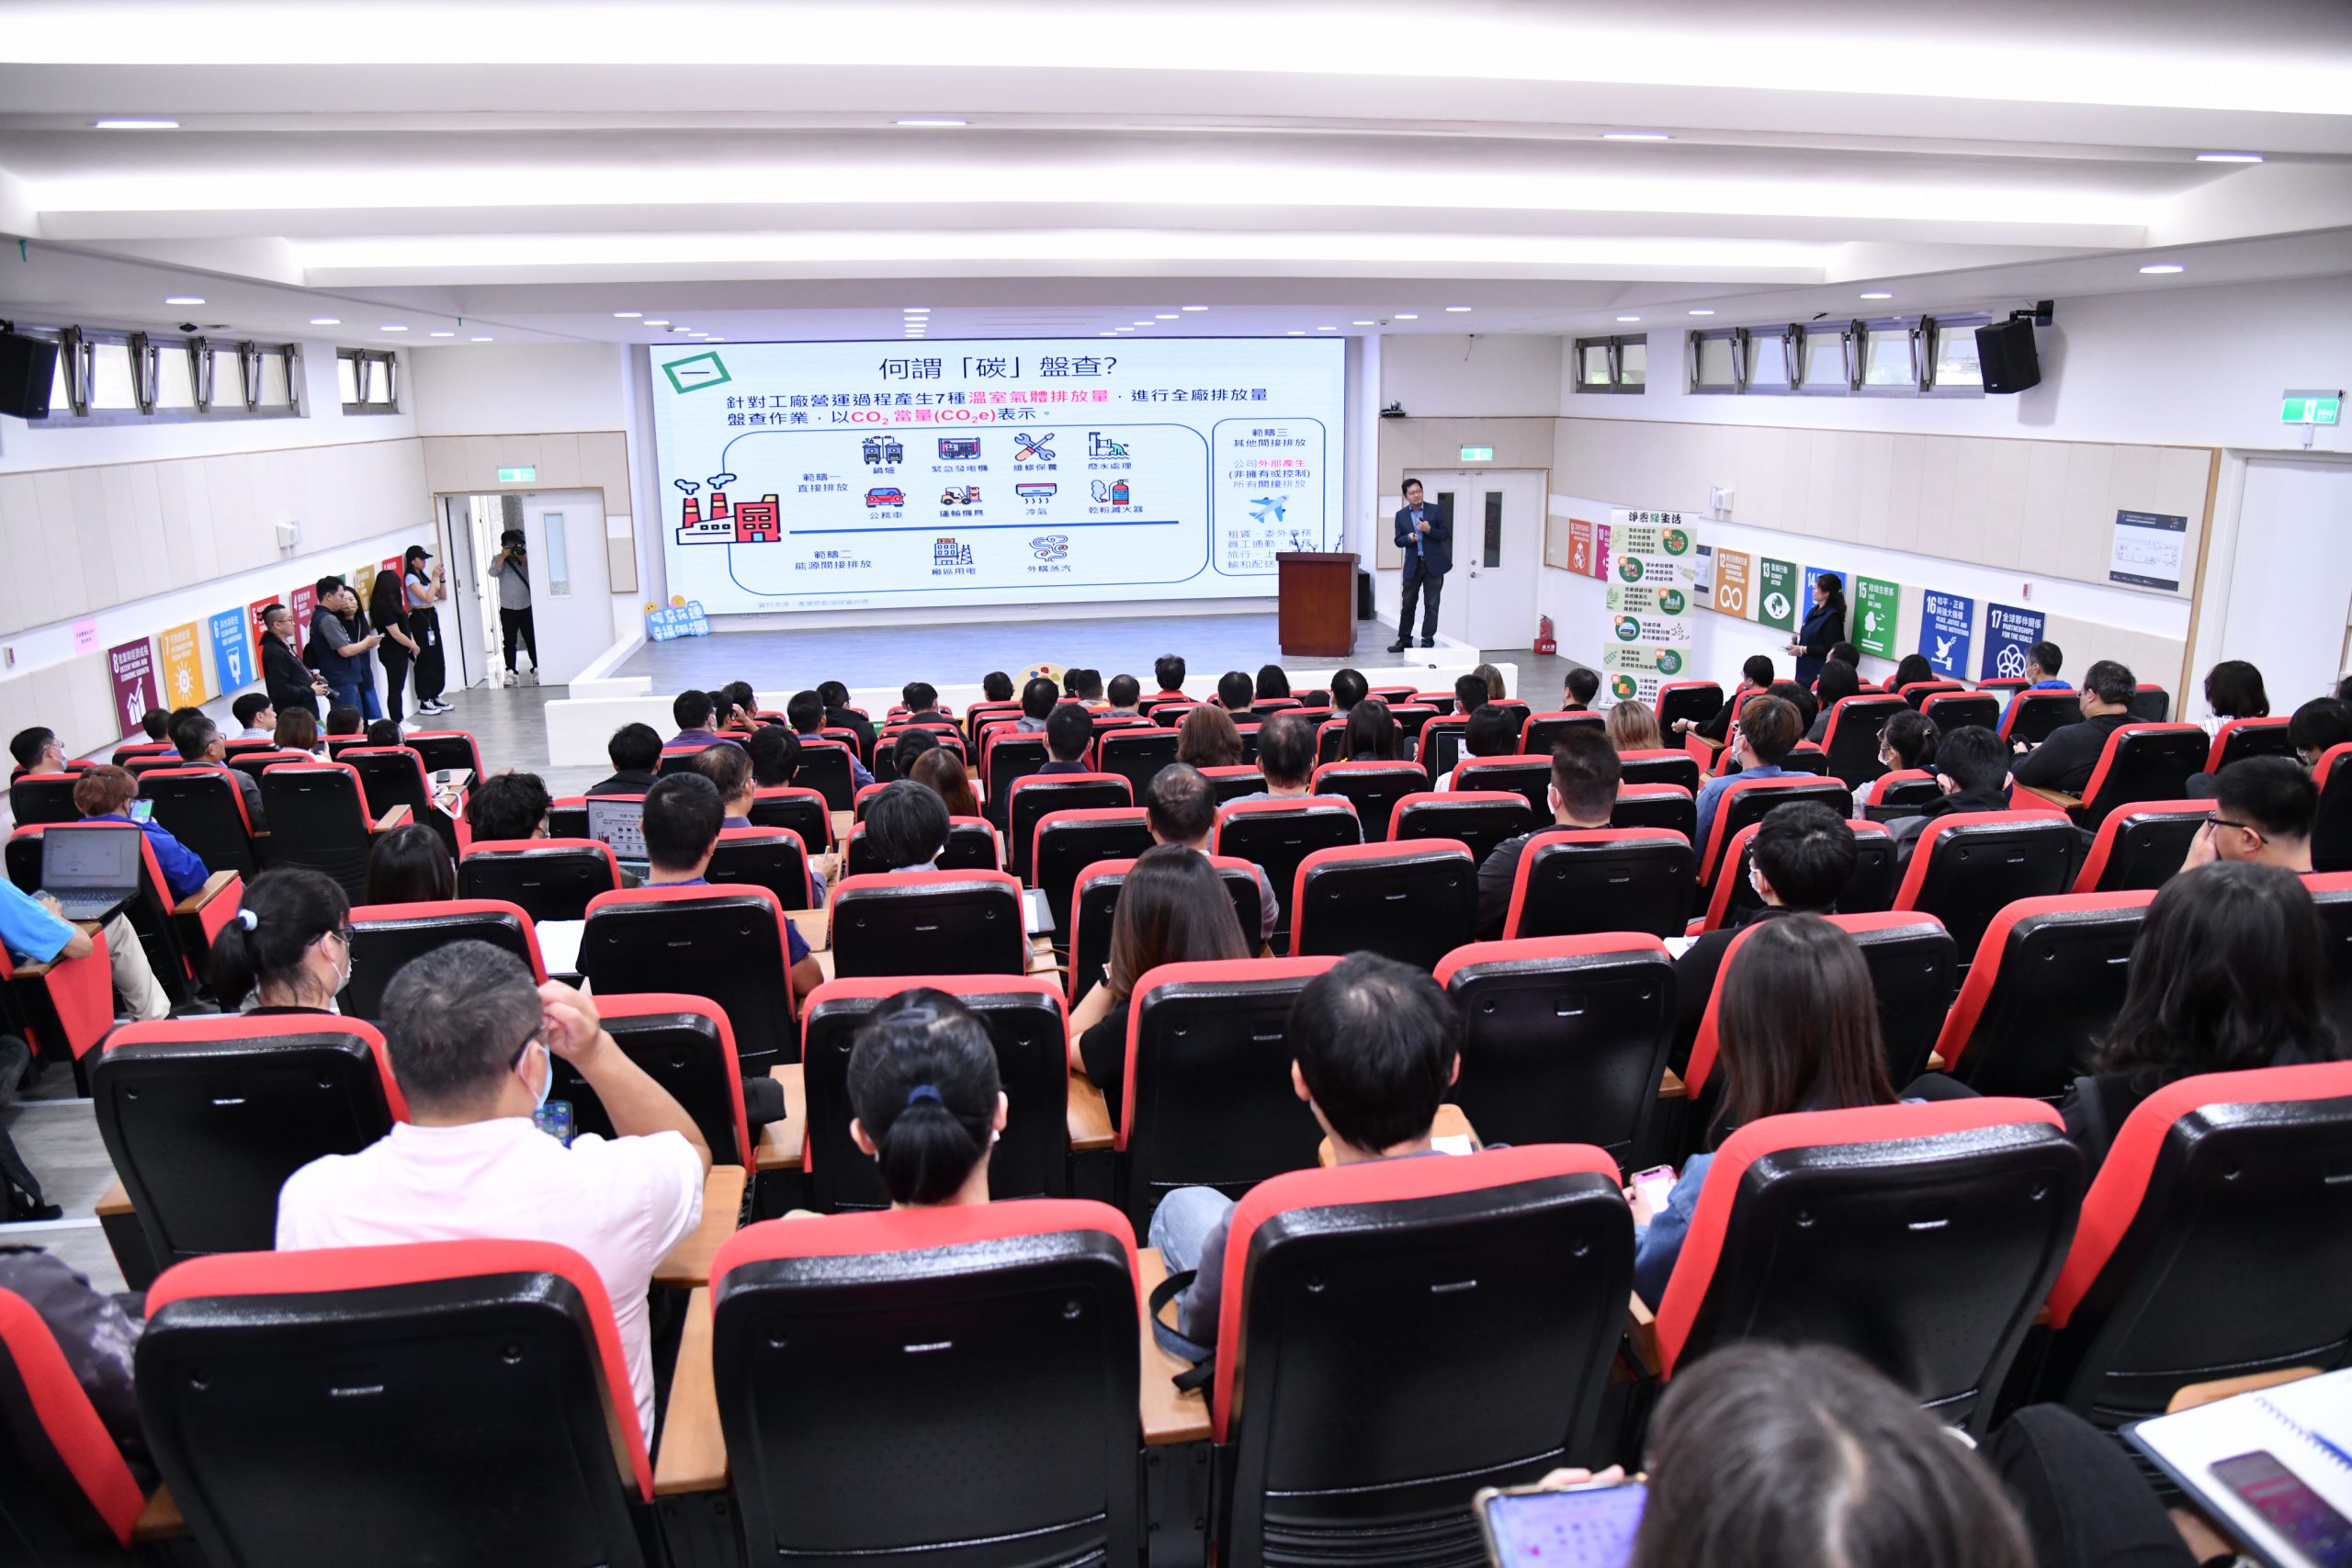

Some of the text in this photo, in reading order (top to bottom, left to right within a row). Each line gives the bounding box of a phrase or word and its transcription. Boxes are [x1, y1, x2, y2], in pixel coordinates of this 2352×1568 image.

[1233, 438, 1306, 447] 其他間接排放
[797, 483, 848, 492] 直接排放
[1025, 507, 1047, 515] 冷氣
[795, 560, 872, 570] 能源間接排放
[1763, 562, 1770, 578] 13
[1858, 581, 1867, 599] 15
[1927, 595, 1937, 615] 16
[1991, 610, 2002, 629] 17
[213, 620, 220, 638] 6
[2002, 623, 2034, 636] PARTNERSHIPS
[2010, 632, 2018, 640] THE
[2018, 634, 2033, 644] GOALS
[112, 653, 119, 674] 8
